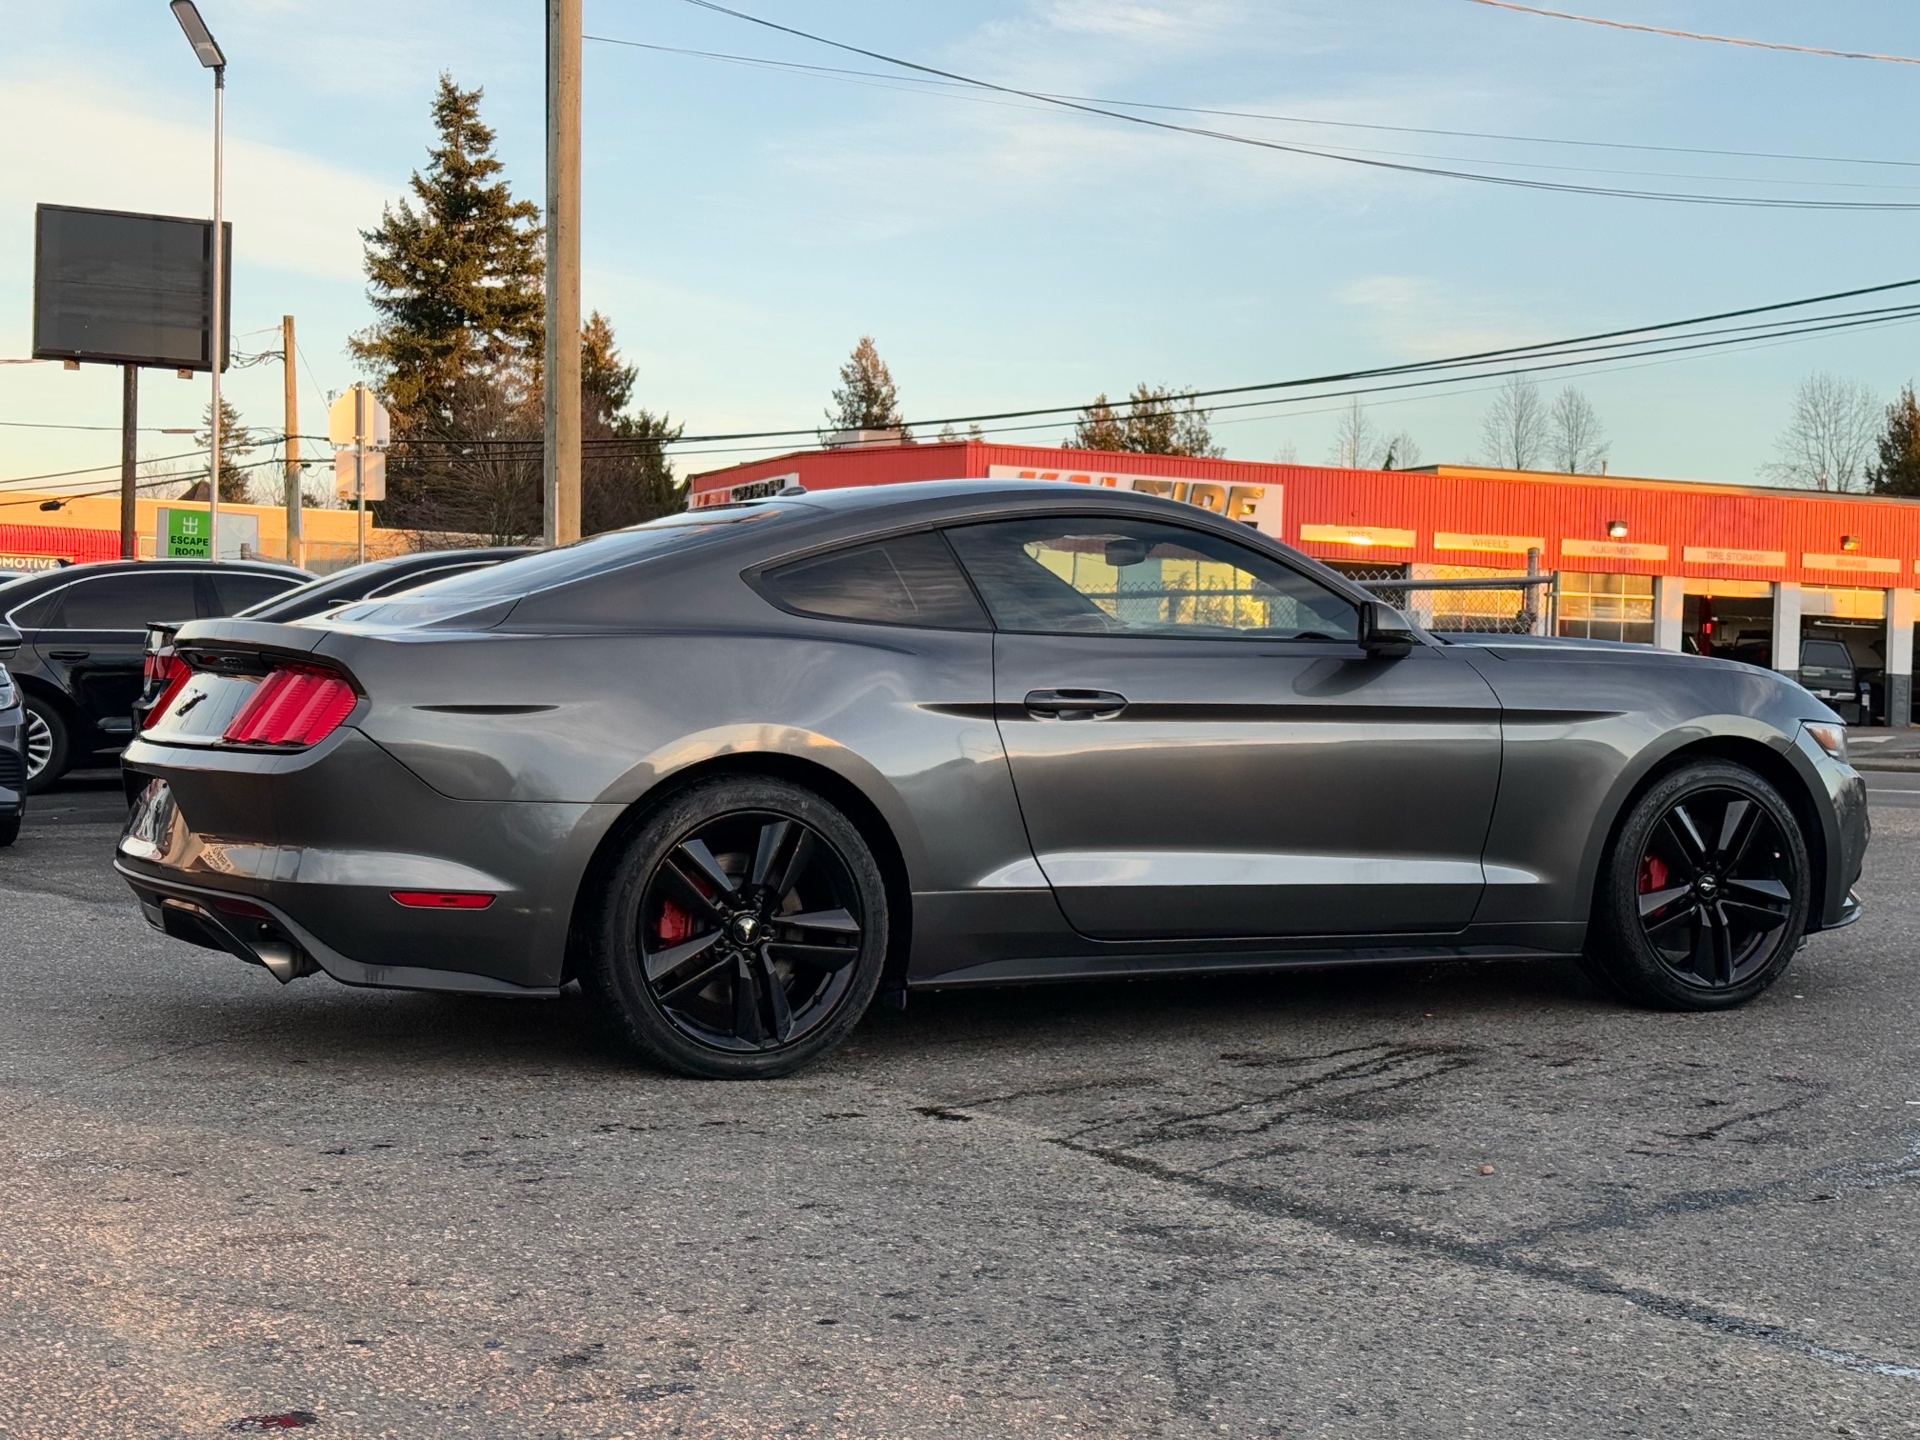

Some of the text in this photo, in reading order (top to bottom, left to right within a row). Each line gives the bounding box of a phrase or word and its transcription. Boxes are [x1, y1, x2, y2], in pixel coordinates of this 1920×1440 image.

[170, 535, 209, 547] ESCAPE
[1472, 538, 1509, 550] WHEELS
[174, 547, 204, 557] ROOM
